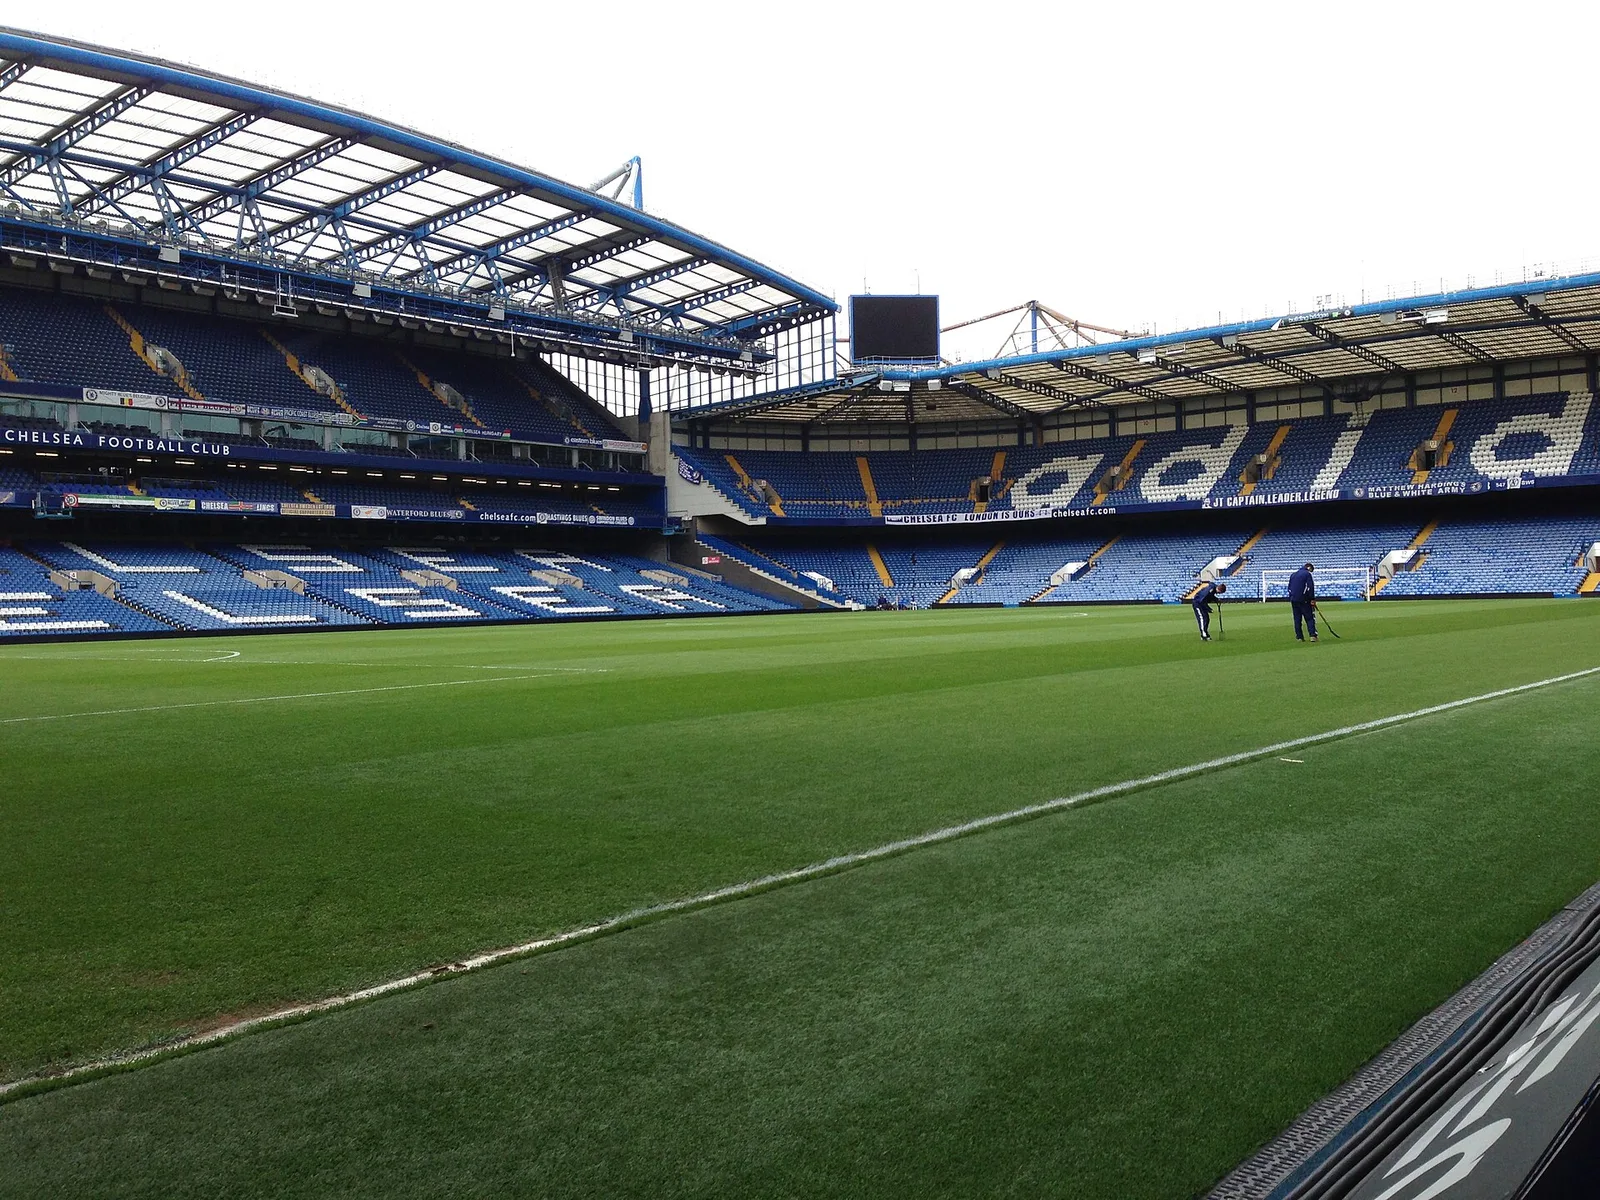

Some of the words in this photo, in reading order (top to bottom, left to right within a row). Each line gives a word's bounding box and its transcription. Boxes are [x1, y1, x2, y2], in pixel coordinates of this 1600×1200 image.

[5, 430, 84, 446] CHELSEA
[99, 436, 185, 453] FOOTBALL
[192, 443, 231, 456] CLUB
[1368, 484, 1416, 492] MATTHEW
[1401, 488, 1433, 497] WHITE
[1437, 486, 1466, 494] ARMY
[201, 500, 229, 510] CHELSEA
[1213, 497, 1224, 507] JT
[386, 509, 429, 518] WATERFORD
[430, 510, 451, 518] BLUES
[479, 512, 536, 522] chelseafc.com
[903, 514, 944, 523] CHELSEA
[946, 513, 958, 521] FC
[964, 511, 999, 521] LONDON
[1001, 511, 1010, 520] IS
[1012, 509, 1036, 519] OURS
[1052, 506, 1117, 518] chelseafc.com
[572, 514, 588, 522] BLUES
